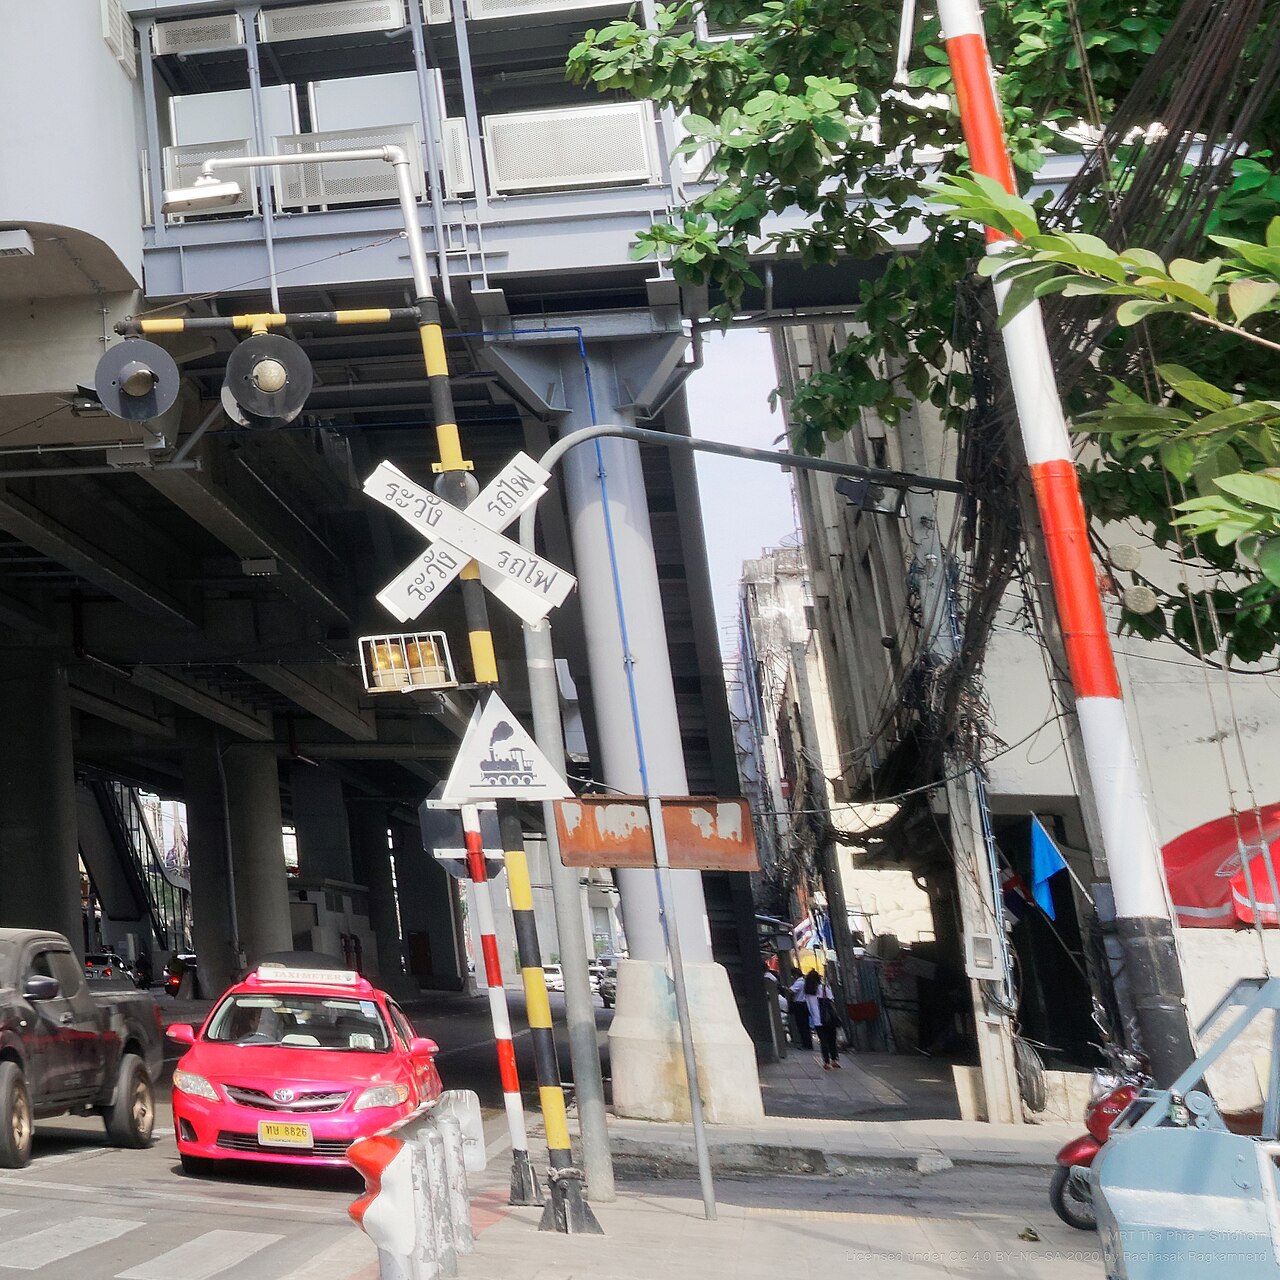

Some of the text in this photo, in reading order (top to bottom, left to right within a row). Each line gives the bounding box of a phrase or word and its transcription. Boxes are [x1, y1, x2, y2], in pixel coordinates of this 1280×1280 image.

[385, 483, 559, 594] ระวัง รถไฟ
[407, 465, 536, 601] ระวัง รถไฟ
